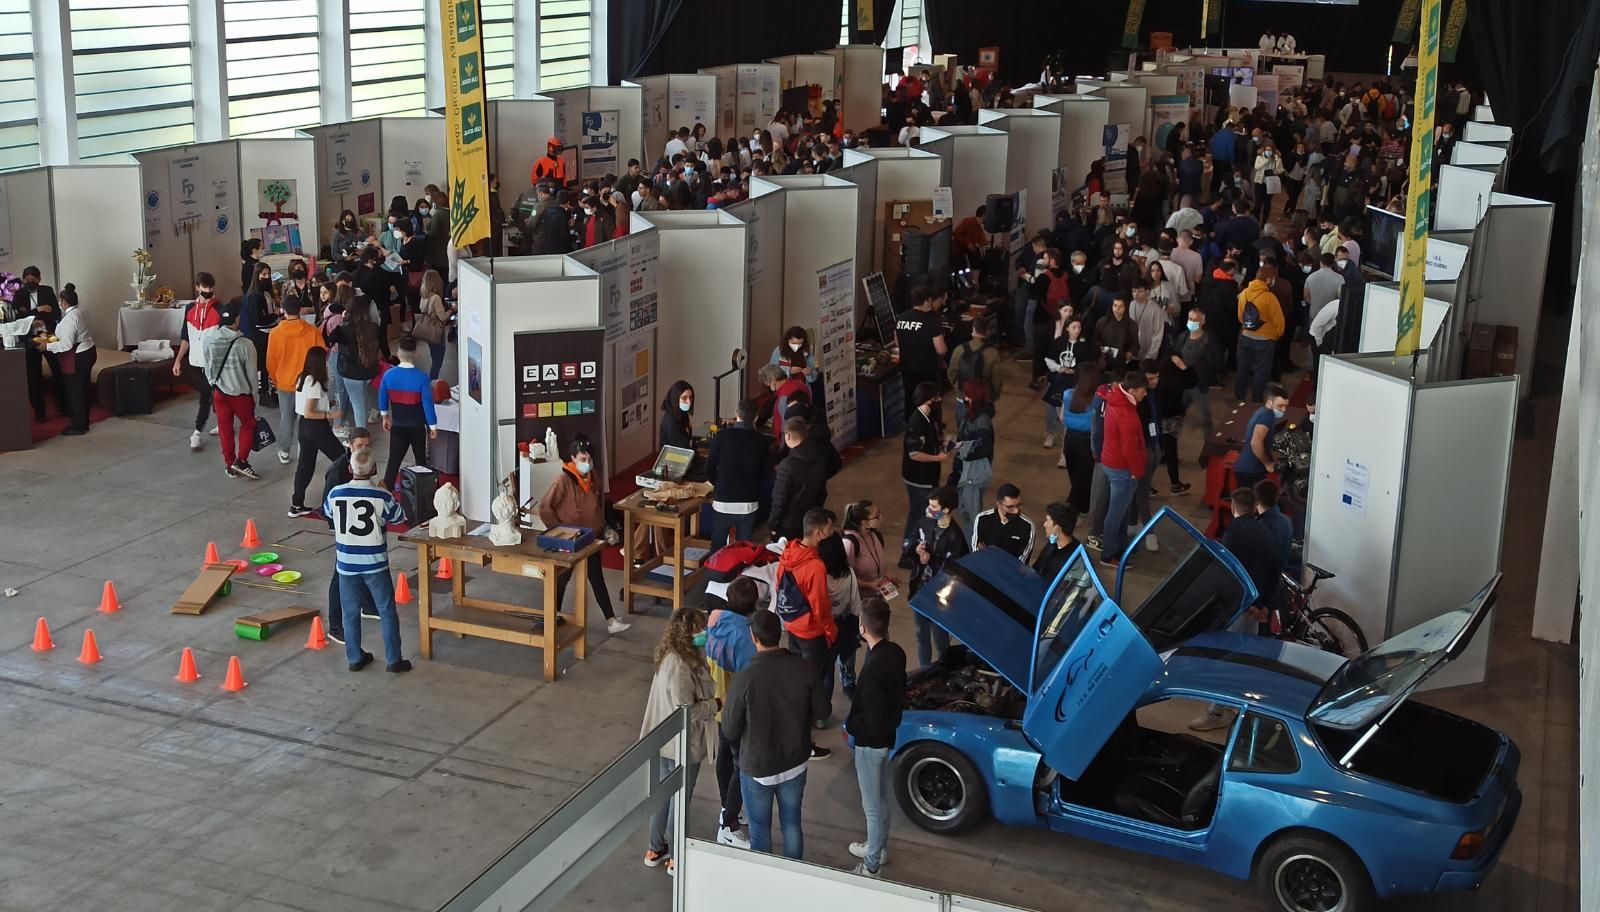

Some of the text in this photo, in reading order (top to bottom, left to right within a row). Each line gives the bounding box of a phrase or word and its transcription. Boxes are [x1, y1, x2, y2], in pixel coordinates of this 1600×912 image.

[896, 320, 923, 331] STAFF
[525, 364, 595, 379] EASD
[335, 499, 376, 537] 13
